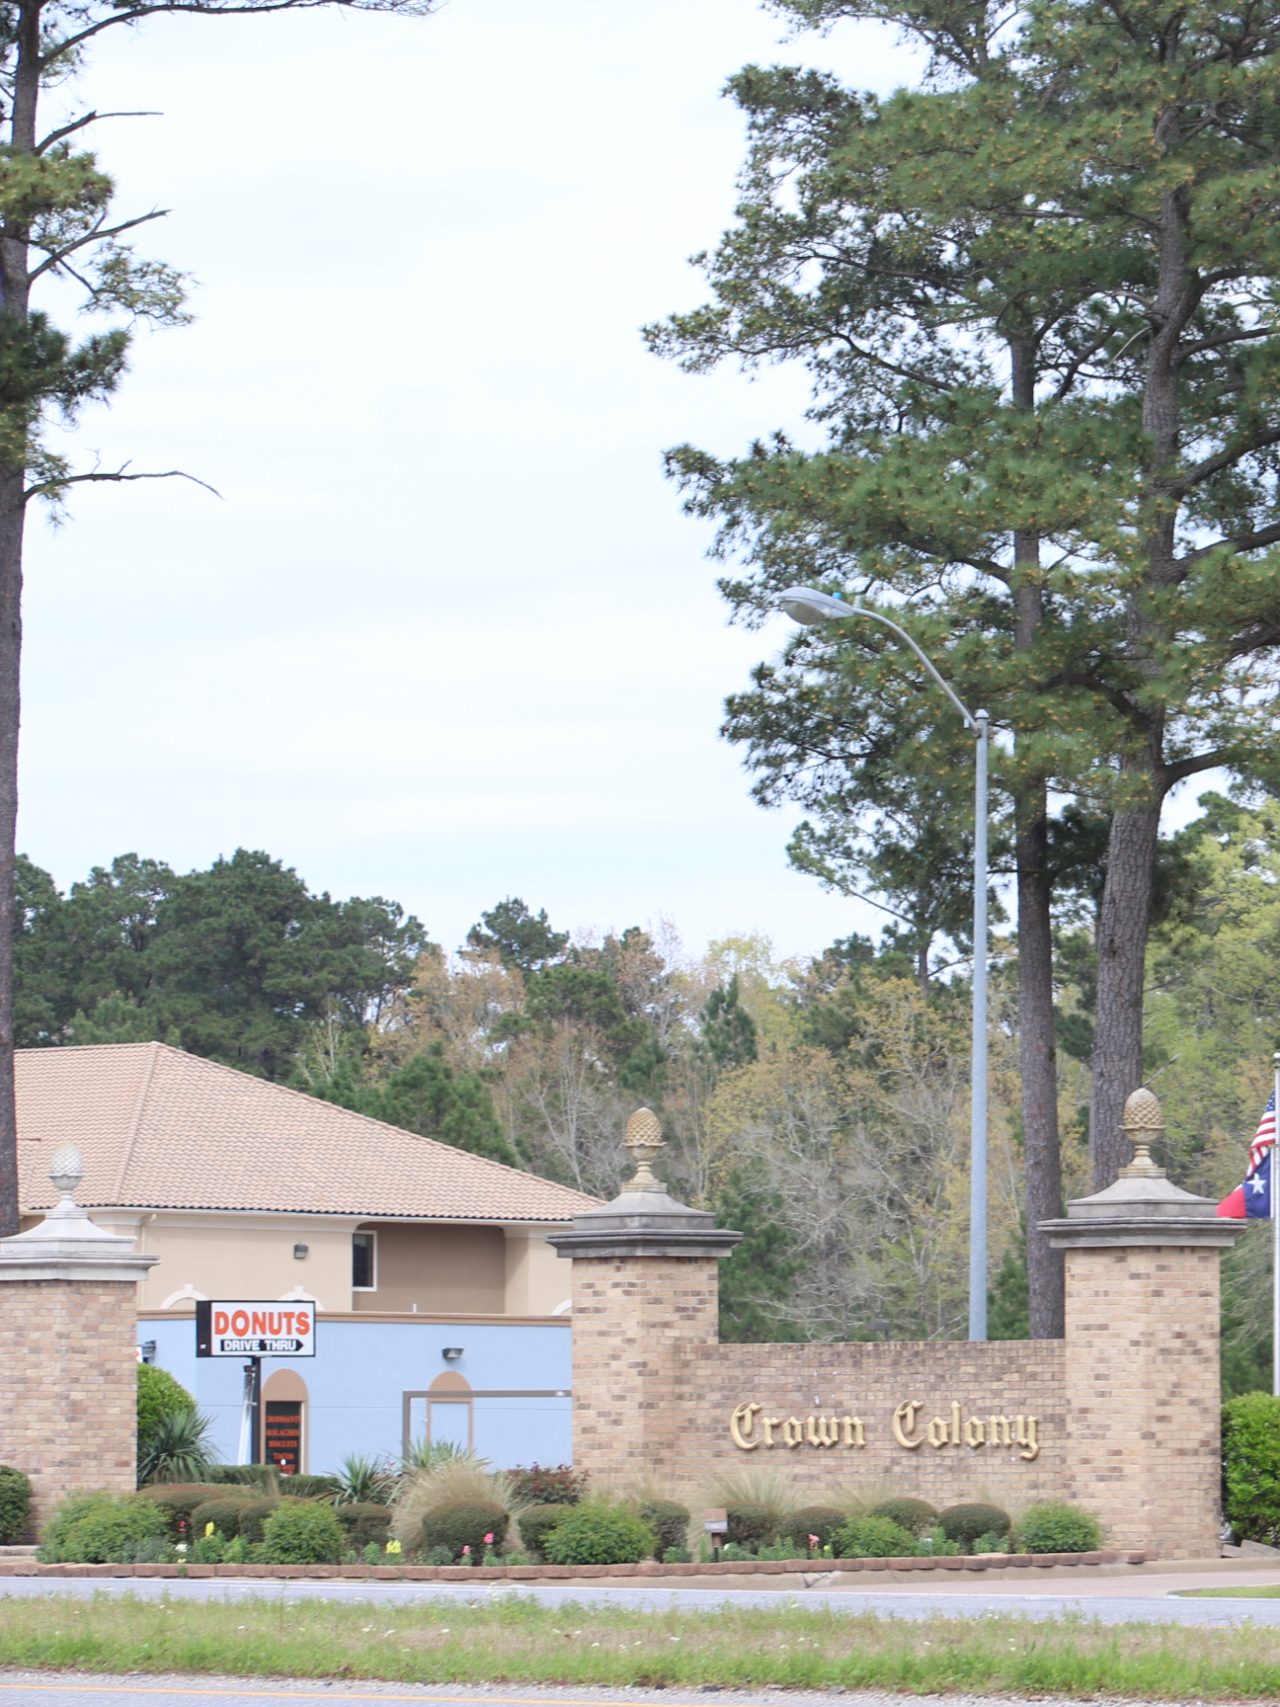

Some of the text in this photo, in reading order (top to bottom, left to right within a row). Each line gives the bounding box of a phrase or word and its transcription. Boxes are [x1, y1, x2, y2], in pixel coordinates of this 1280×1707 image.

[214, 1310, 310, 1337] DONUTS
[224, 1340, 297, 1351] DRIVE THRU
[730, 1400, 1040, 1461] Crown Colony
